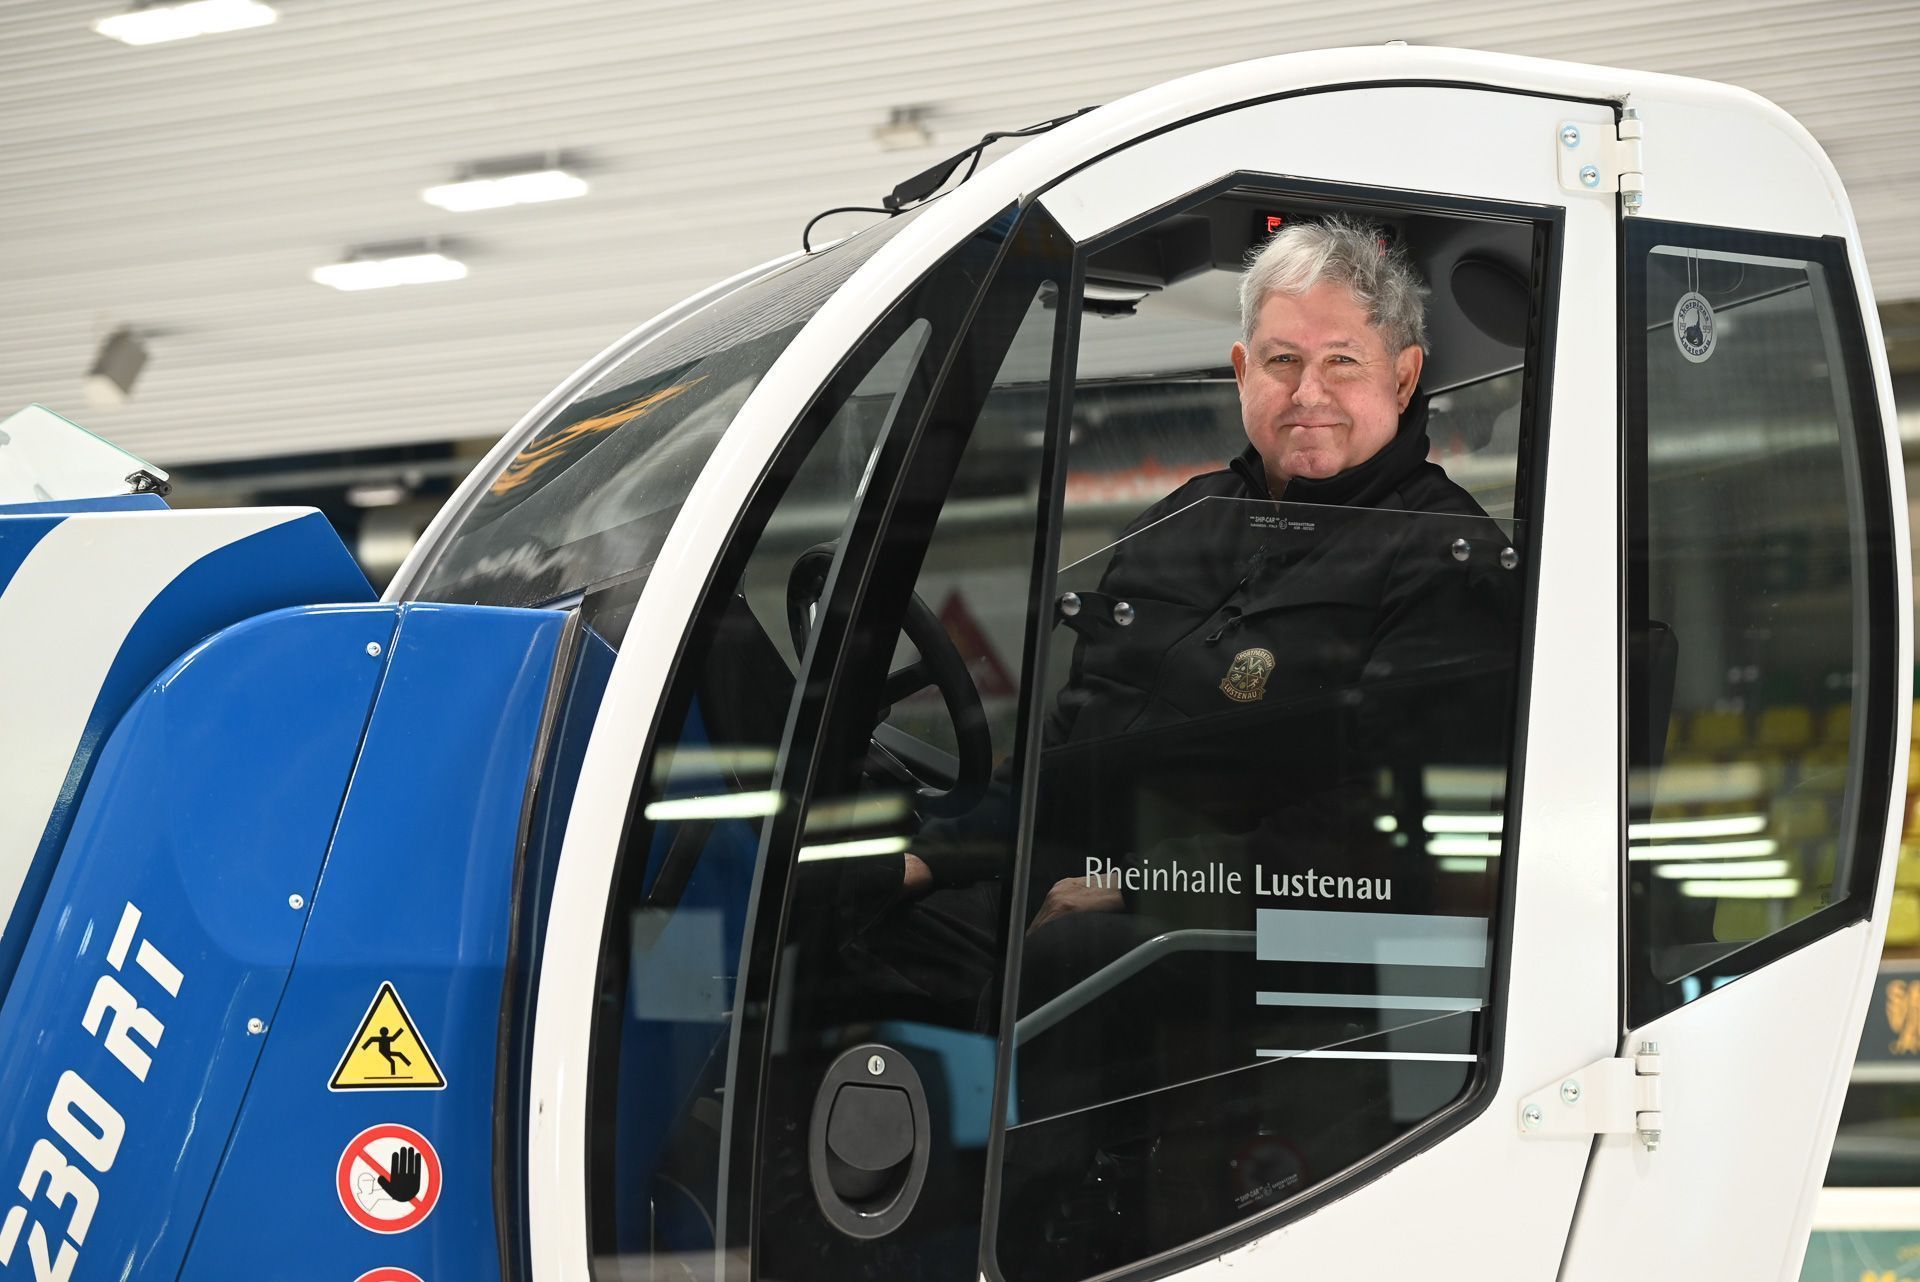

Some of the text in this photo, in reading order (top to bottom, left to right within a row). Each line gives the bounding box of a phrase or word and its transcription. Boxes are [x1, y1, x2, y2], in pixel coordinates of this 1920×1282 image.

[1679, 301, 1710, 322] Skorpions
[1223, 682, 1258, 700] LUSTENAU
[1085, 856, 1392, 900] Rheinhalle Lustenau
[0, 900, 185, 1282] 230 RT
